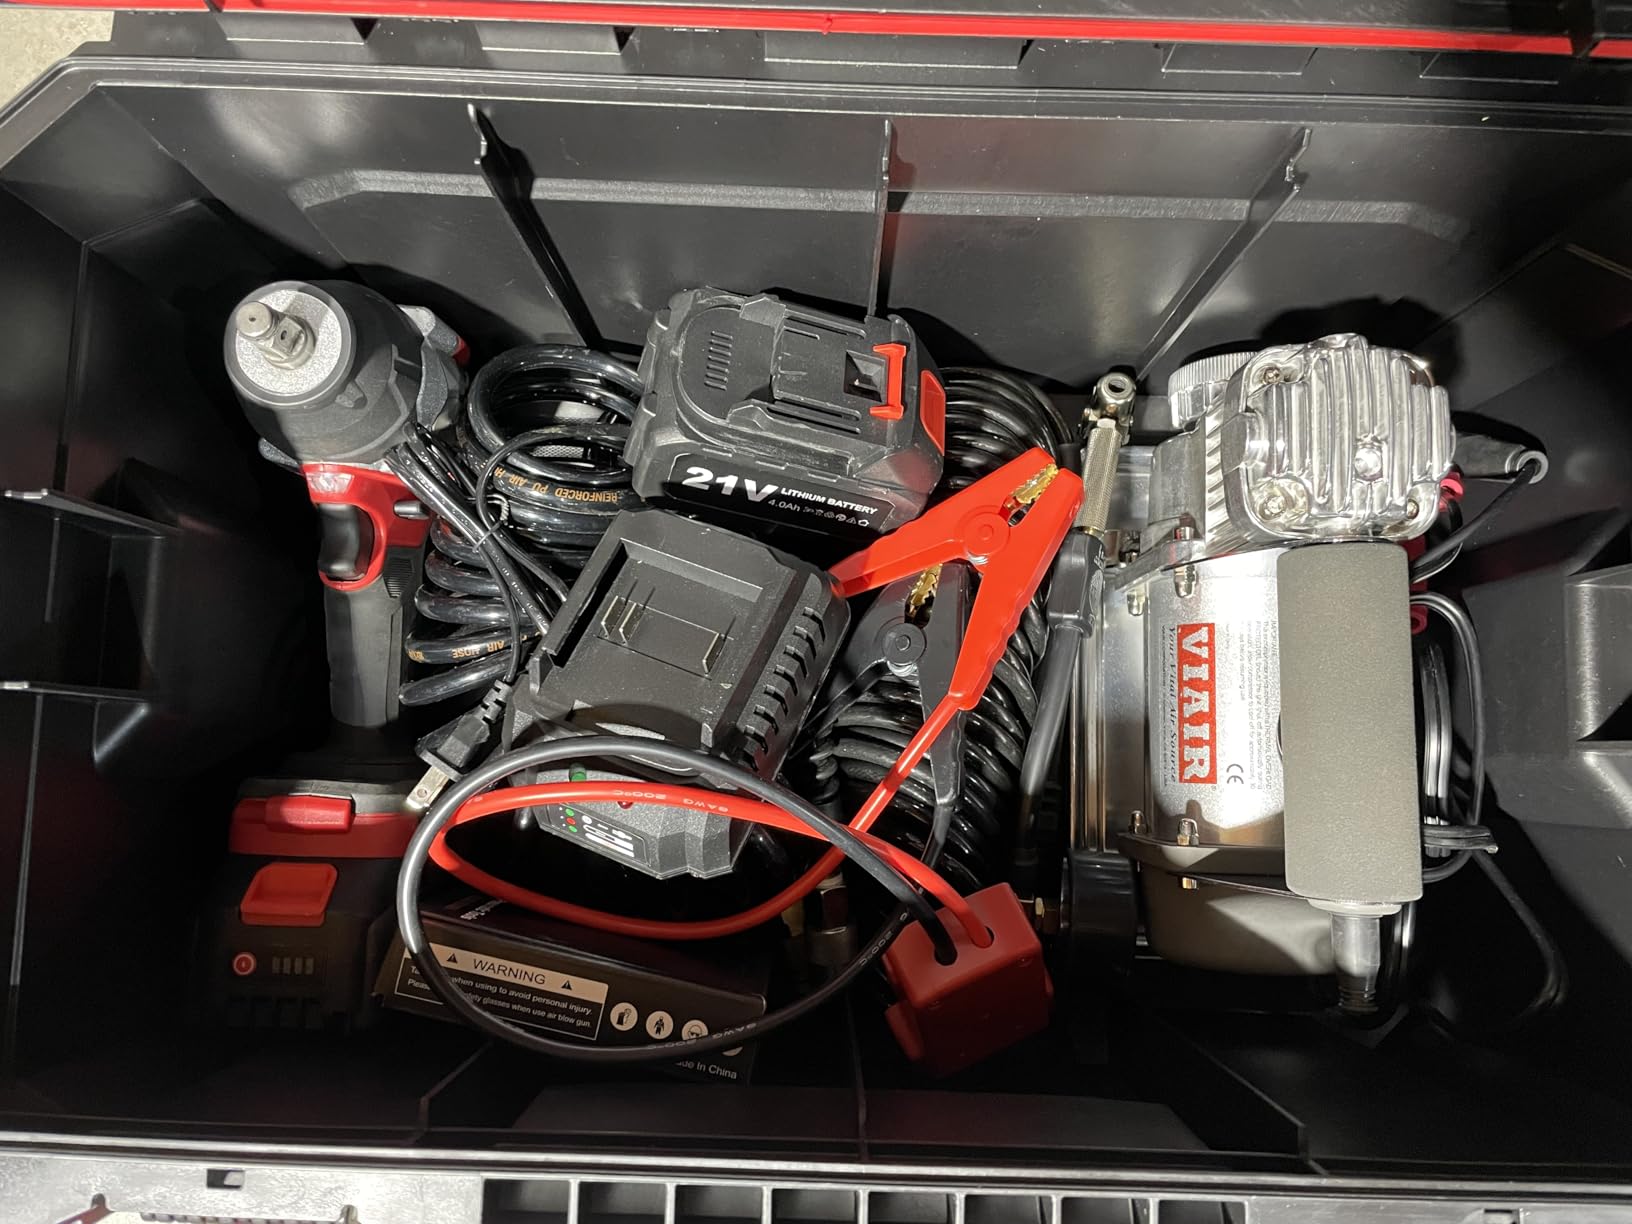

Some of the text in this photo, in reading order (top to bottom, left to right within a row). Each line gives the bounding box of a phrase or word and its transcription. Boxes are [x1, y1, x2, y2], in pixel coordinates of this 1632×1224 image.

[508, 473, 528, 486] AIR
[532, 482, 548, 494] PU
[681, 466, 780, 502] 21V
[555, 487, 618, 503] REINFORCED
[768, 499, 800, 512] 4.0Ah
[781, 487, 878, 515] LITHIUM BATTERY
[452, 640, 505, 659] AIR HOSE
[1169, 663, 1177, 699] Vital
[1182, 626, 1210, 780] VIAIR
[472, 958, 546, 985] WARNING
[475, 983, 497, 993] using
[499, 987, 508, 995] to
[508, 989, 531, 1000] avoid
[532, 995, 567, 1009] personal
[569, 1003, 593, 1016] injury.
[482, 997, 510, 1009] glasses
[511, 1003, 531, 1014] when
[532, 1009, 546, 1017] use
[558, 1013, 575, 1024] blow
[708, 1064, 737, 1080] China
